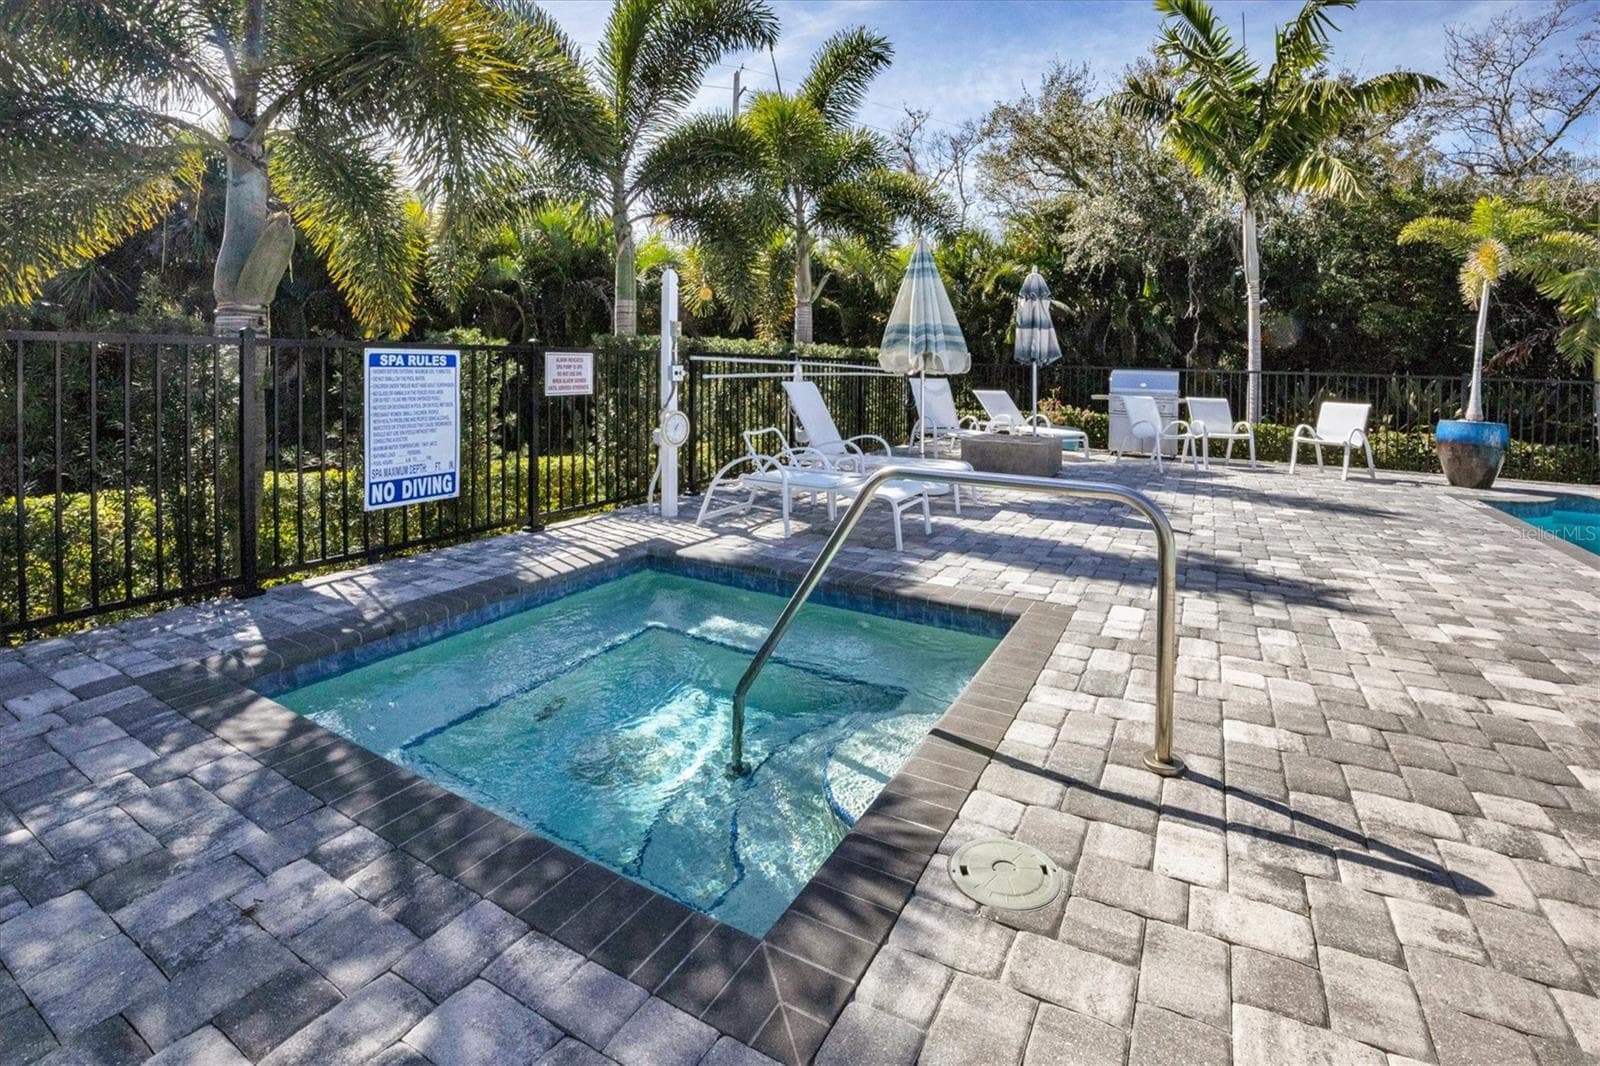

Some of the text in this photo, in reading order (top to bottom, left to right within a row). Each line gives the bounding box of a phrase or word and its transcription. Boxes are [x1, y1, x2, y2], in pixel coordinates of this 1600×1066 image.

[380, 354, 447, 366] SPA RULES
[372, 469, 382, 479] SPA
[383, 465, 409, 477] MAXIMUM
[371, 474, 453, 504] NO DIVING
